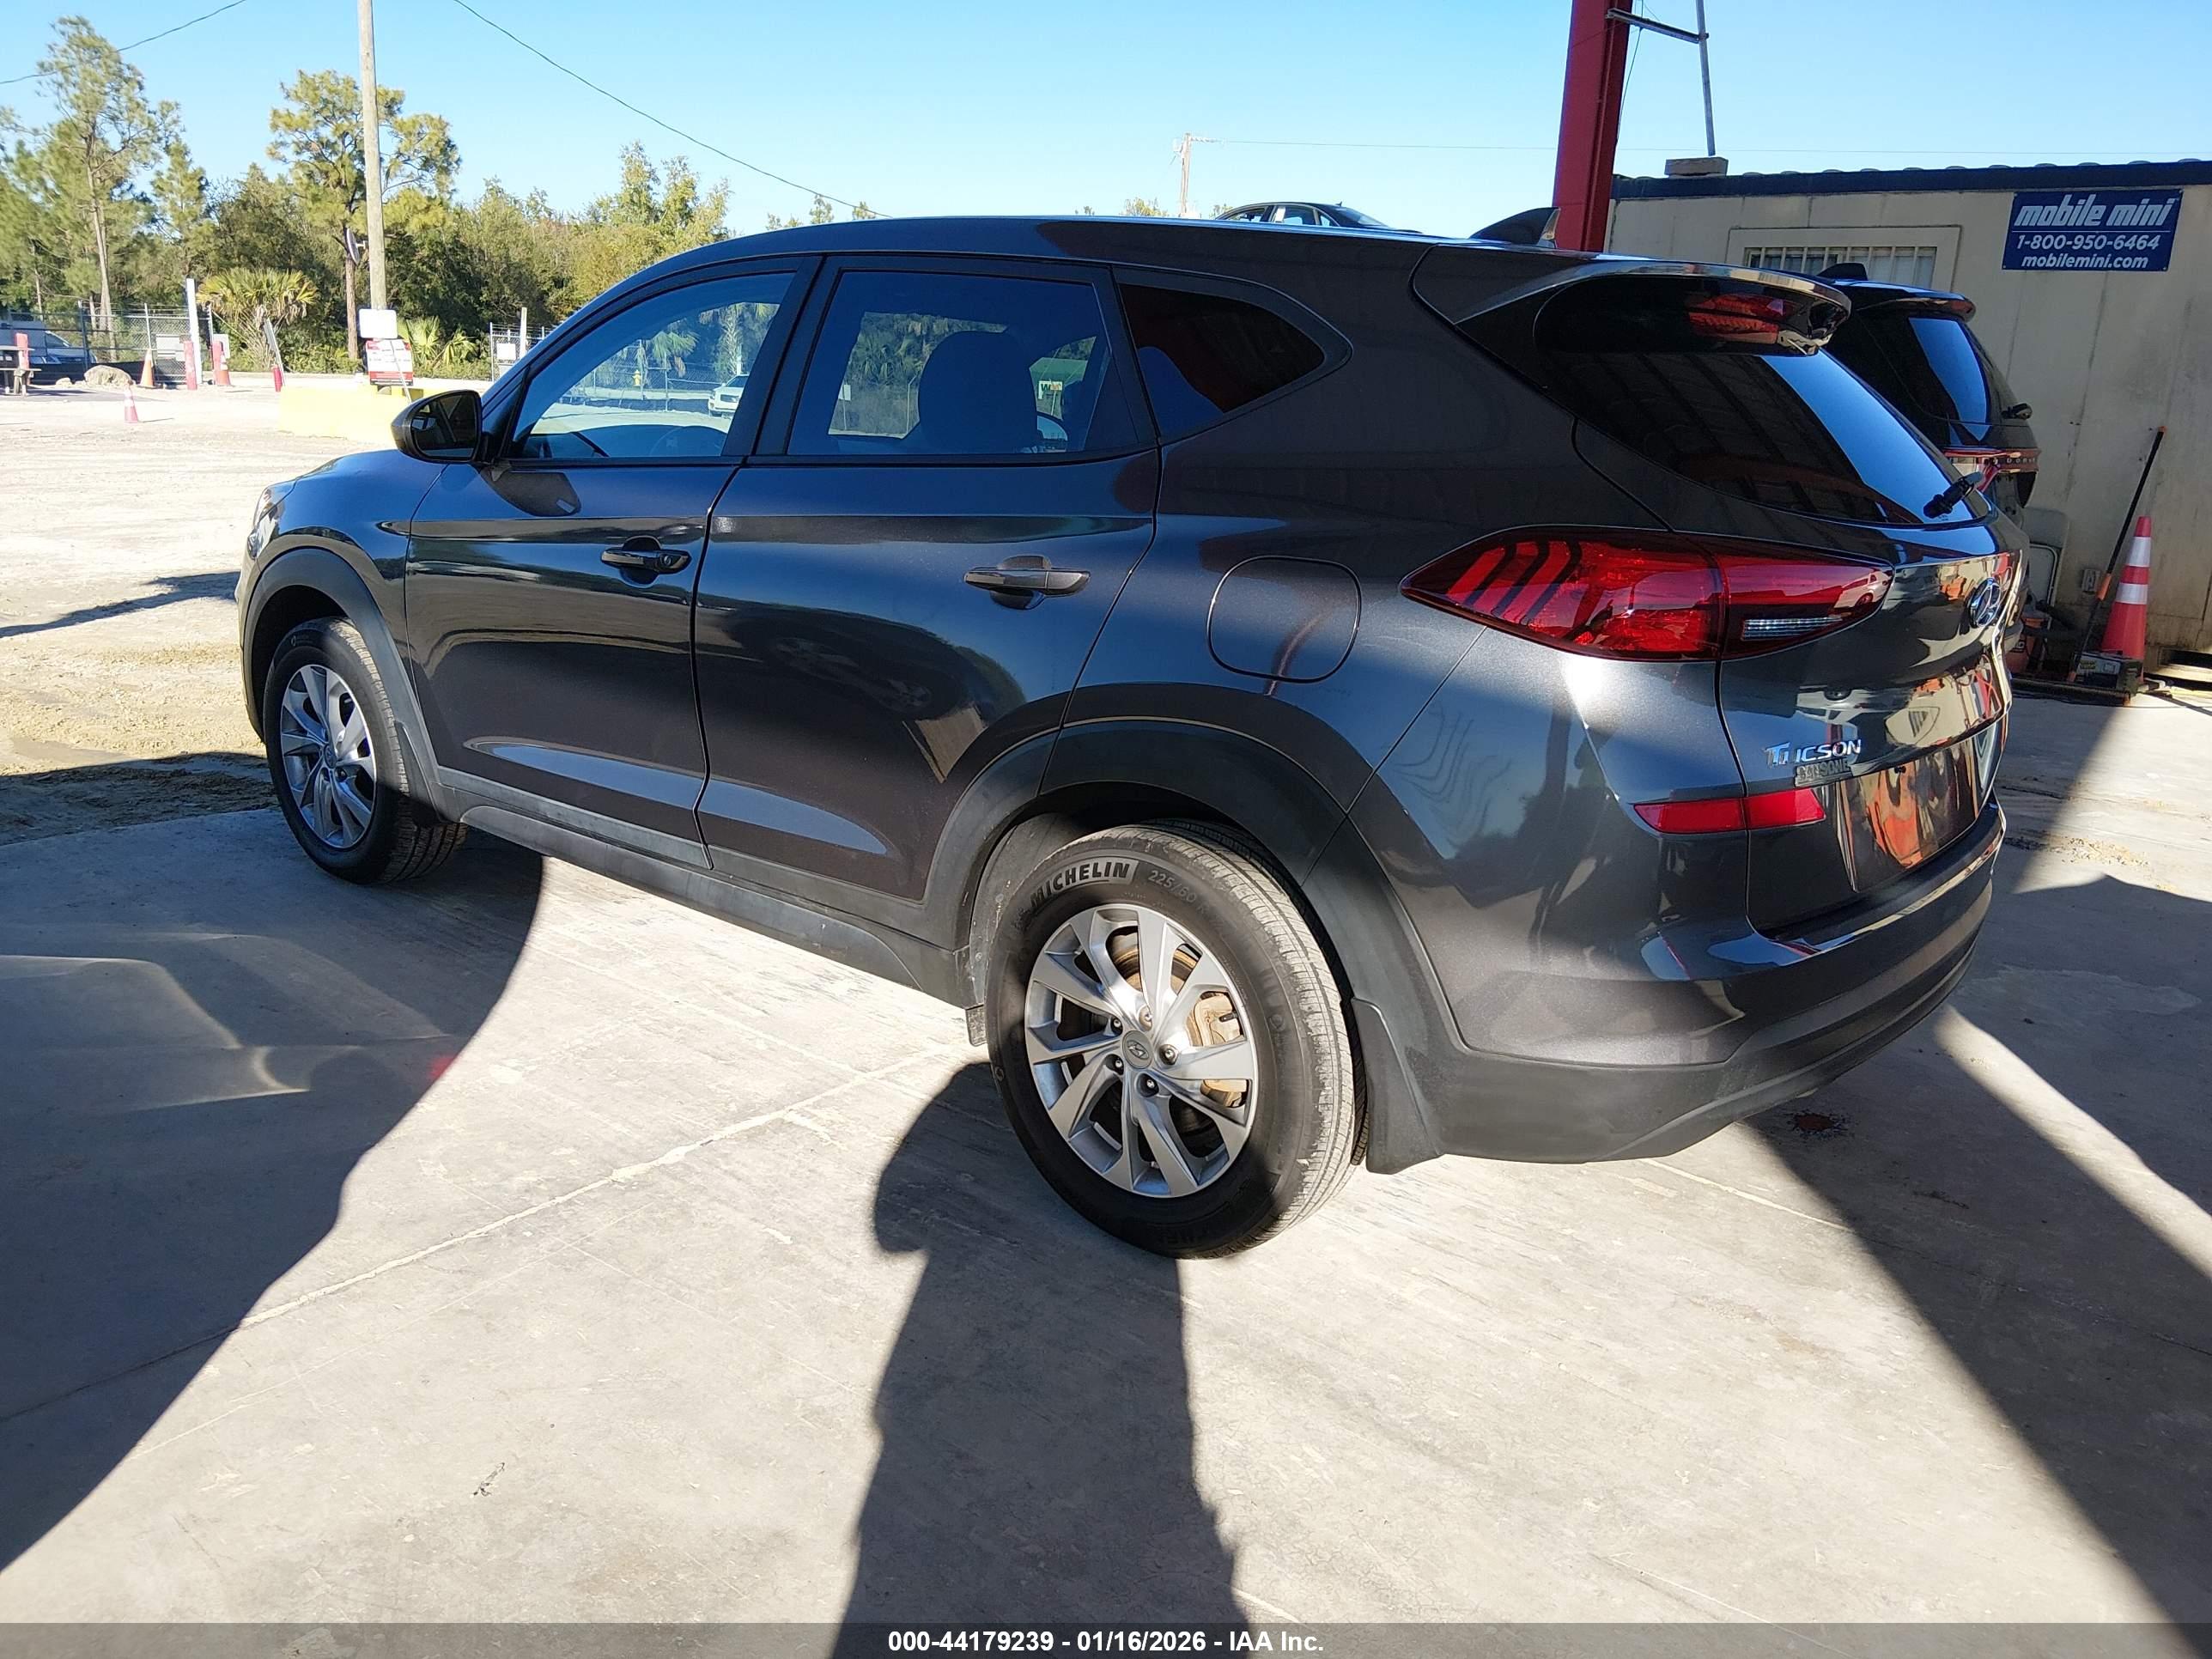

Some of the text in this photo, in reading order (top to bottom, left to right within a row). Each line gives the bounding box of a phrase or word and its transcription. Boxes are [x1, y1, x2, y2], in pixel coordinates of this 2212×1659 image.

[2014, 194, 2178, 226] mobile mini
[2017, 234, 2160, 250] 1-800-950-6464
[2021, 253, 2148, 268] mobilemini.com
[1765, 738, 1862, 766] TUCSON
[1030, 861, 1131, 908] MICHELIN
